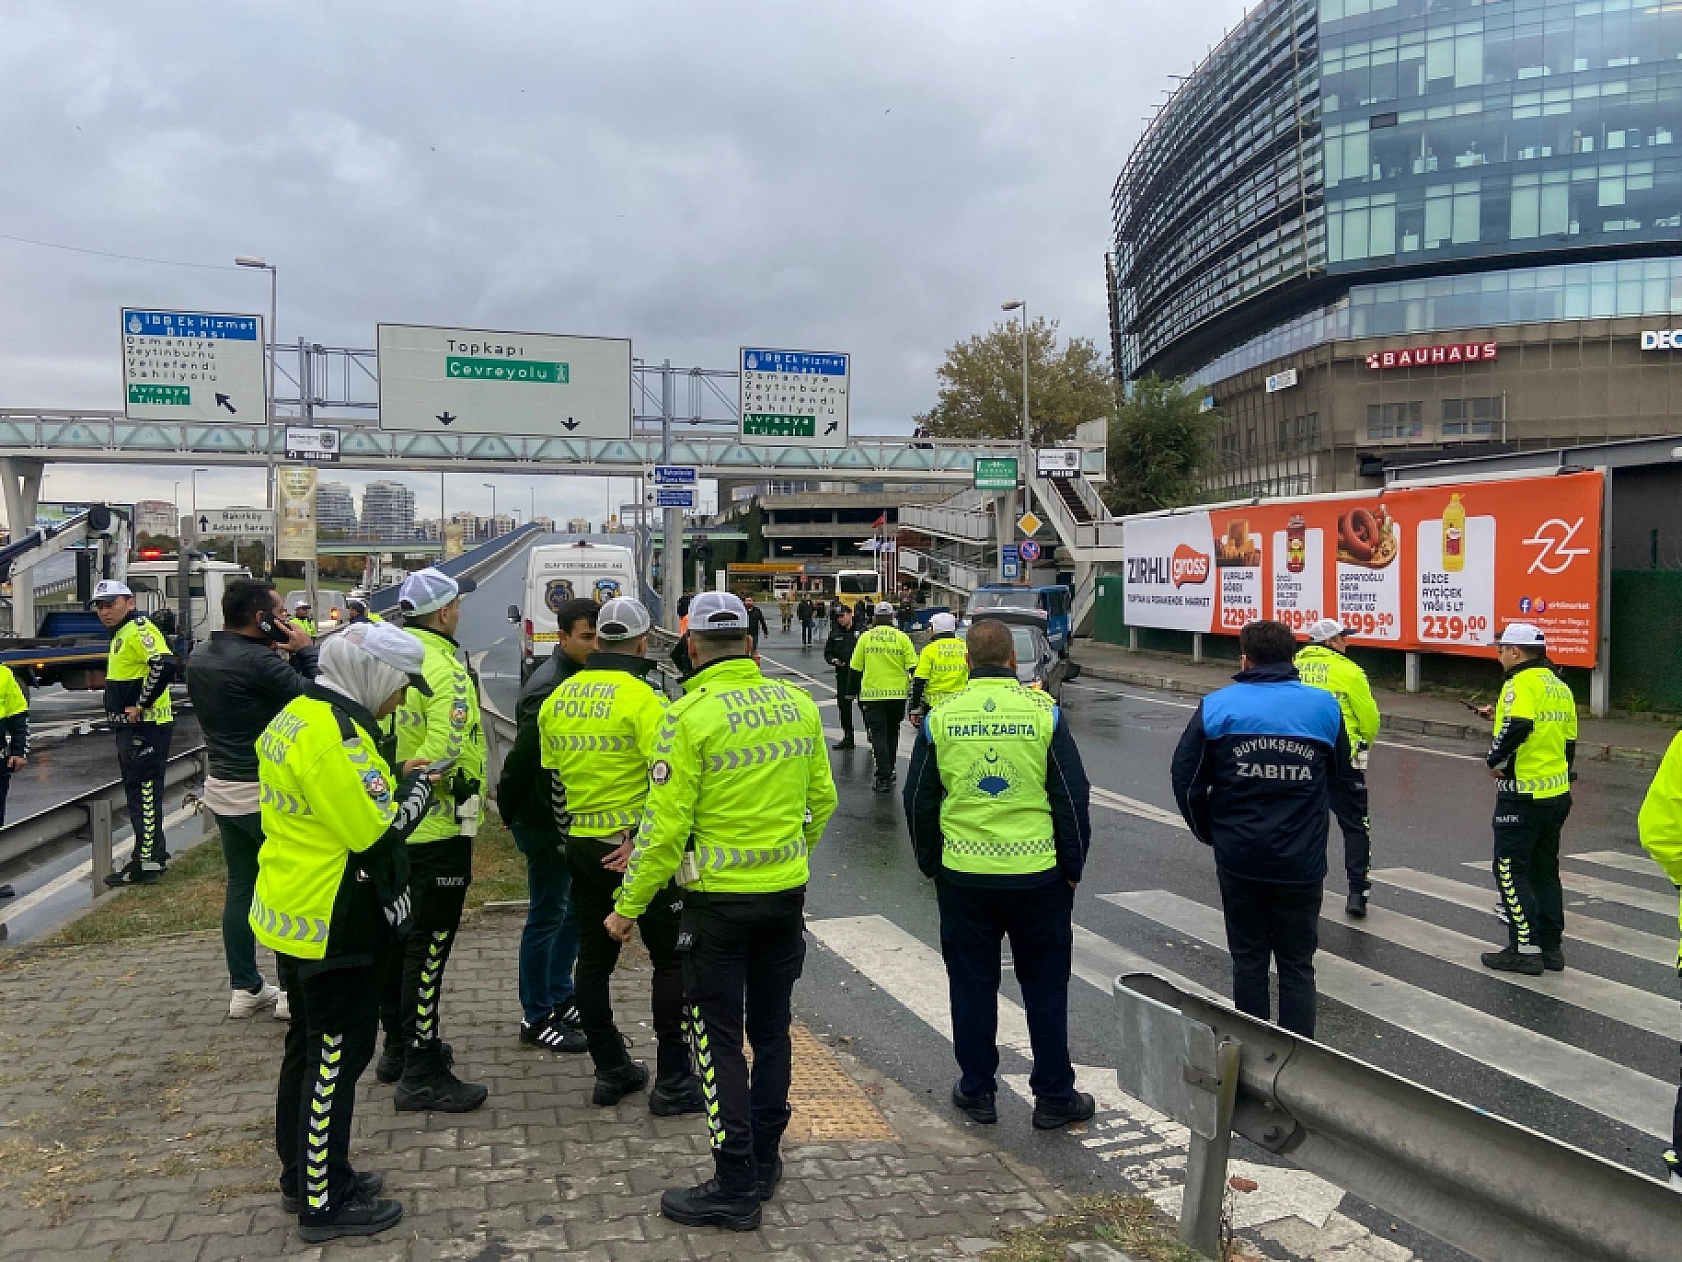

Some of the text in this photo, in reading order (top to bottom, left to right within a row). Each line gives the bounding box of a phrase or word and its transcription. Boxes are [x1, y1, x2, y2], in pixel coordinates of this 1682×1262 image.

[178, 316, 194, 327] Ek
[201, 317, 255, 330] Hizmet
[127, 336, 215, 349] Osmaniye
[447, 340, 524, 357] Topkapı
[127, 346, 216, 359] Zeytinburnu
[1383, 342, 1497, 365] BAUHAUS
[129, 358, 217, 370] Veliefendi
[802, 355, 845, 367] Hizmet
[129, 368, 217, 381] Sahilyolu
[450, 361, 548, 380] Çevreyolu
[745, 371, 829, 384] Osmaniye
[130, 384, 189, 395] Avrasya
[745, 380, 846, 394] Zeytinburnu
[745, 391, 835, 405] Veliefendi
[745, 402, 835, 415] Sahilyolu
[745, 413, 809, 426] Avrasya
[1127, 556, 1206, 584] ZIRHLI gross
[1422, 572, 1449, 584] BİZCE
[1422, 585, 1462, 600] AYÇİÇEK
[1422, 599, 1444, 611] YAĞI
[1453, 602, 1465, 611] LT
[560, 681, 622, 699] TRAFİK
[716, 684, 794, 710] TRAFİK
[553, 698, 613, 720] POLİSİ
[726, 701, 802, 734] POLİSİ
[947, 720, 1035, 737] TRAFİK ZABITA
[1236, 761, 1313, 780] ZABITA
